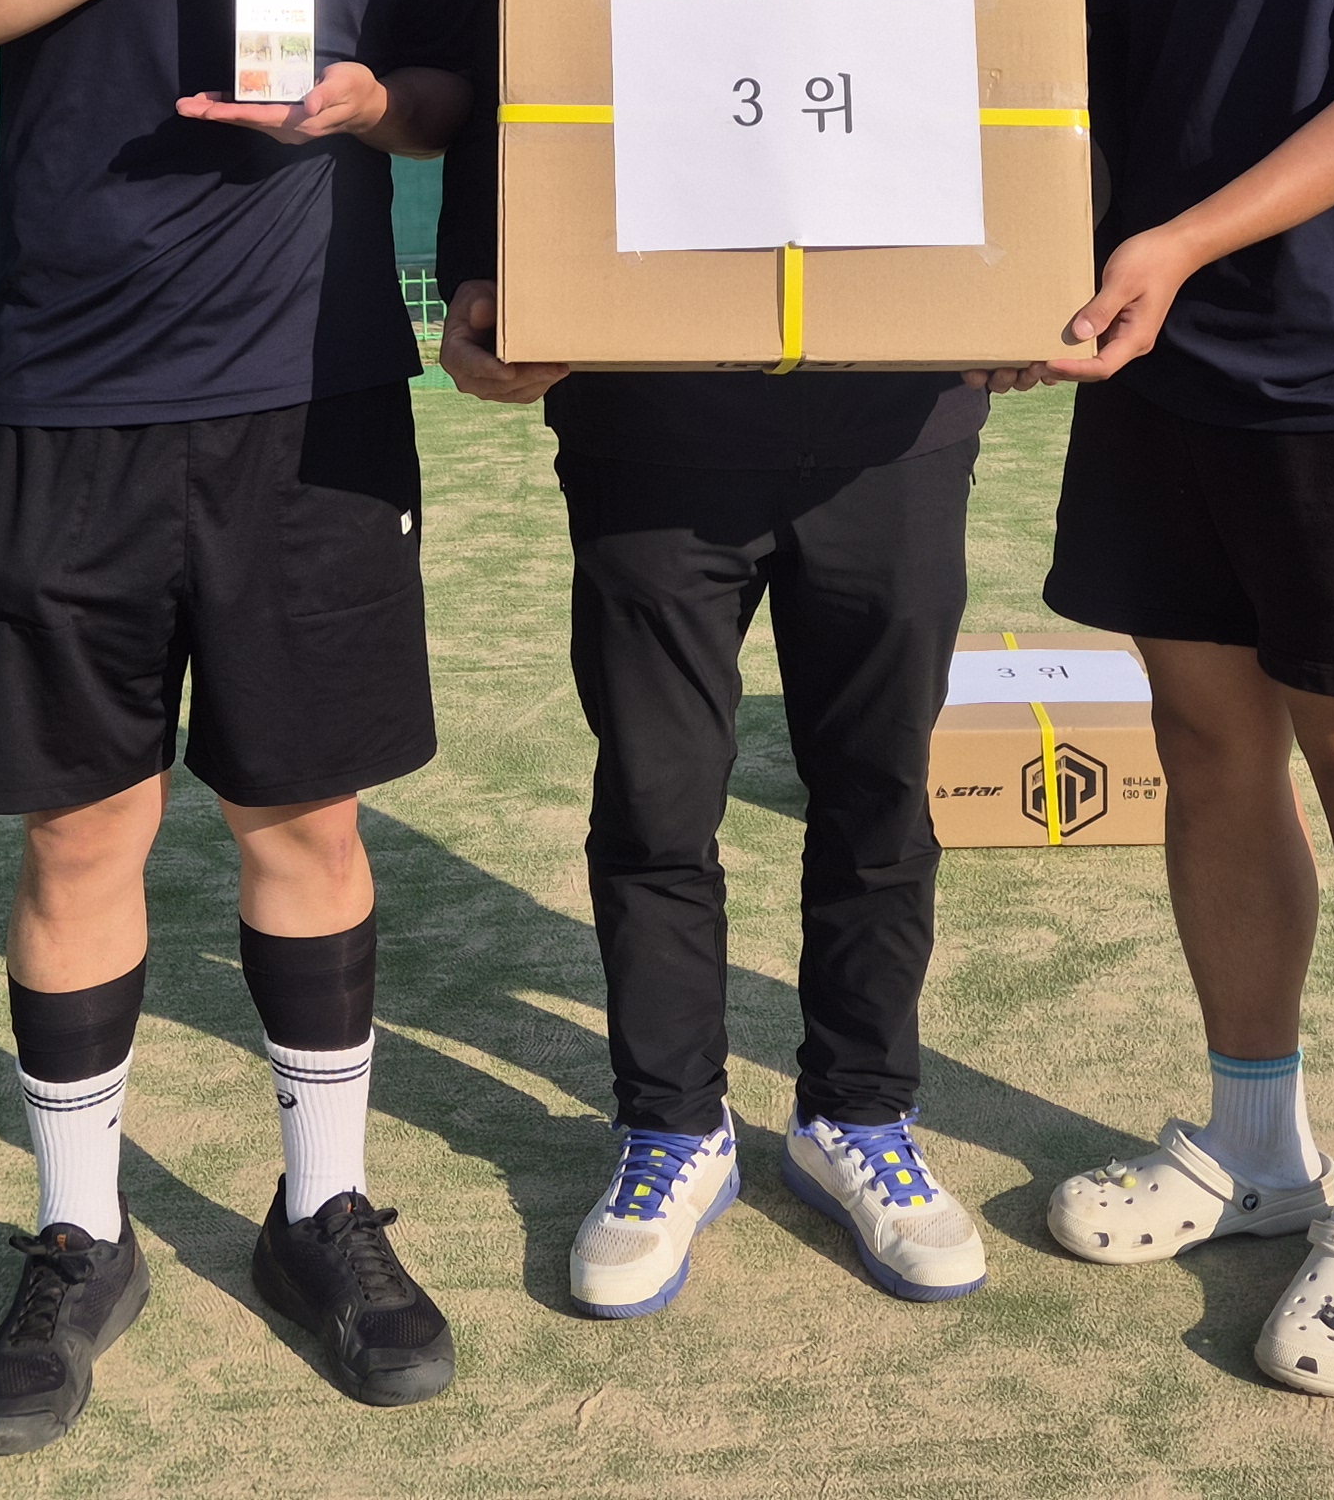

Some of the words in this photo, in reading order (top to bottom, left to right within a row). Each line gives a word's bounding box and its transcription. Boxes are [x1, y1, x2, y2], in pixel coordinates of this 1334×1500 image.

[732, 76, 764, 127] 3
[801, 71, 854, 134] 위
[997, 666, 1016, 679] 3
[1038, 665, 1069, 679] 위
[1122, 776, 1161, 787] 테니스볼
